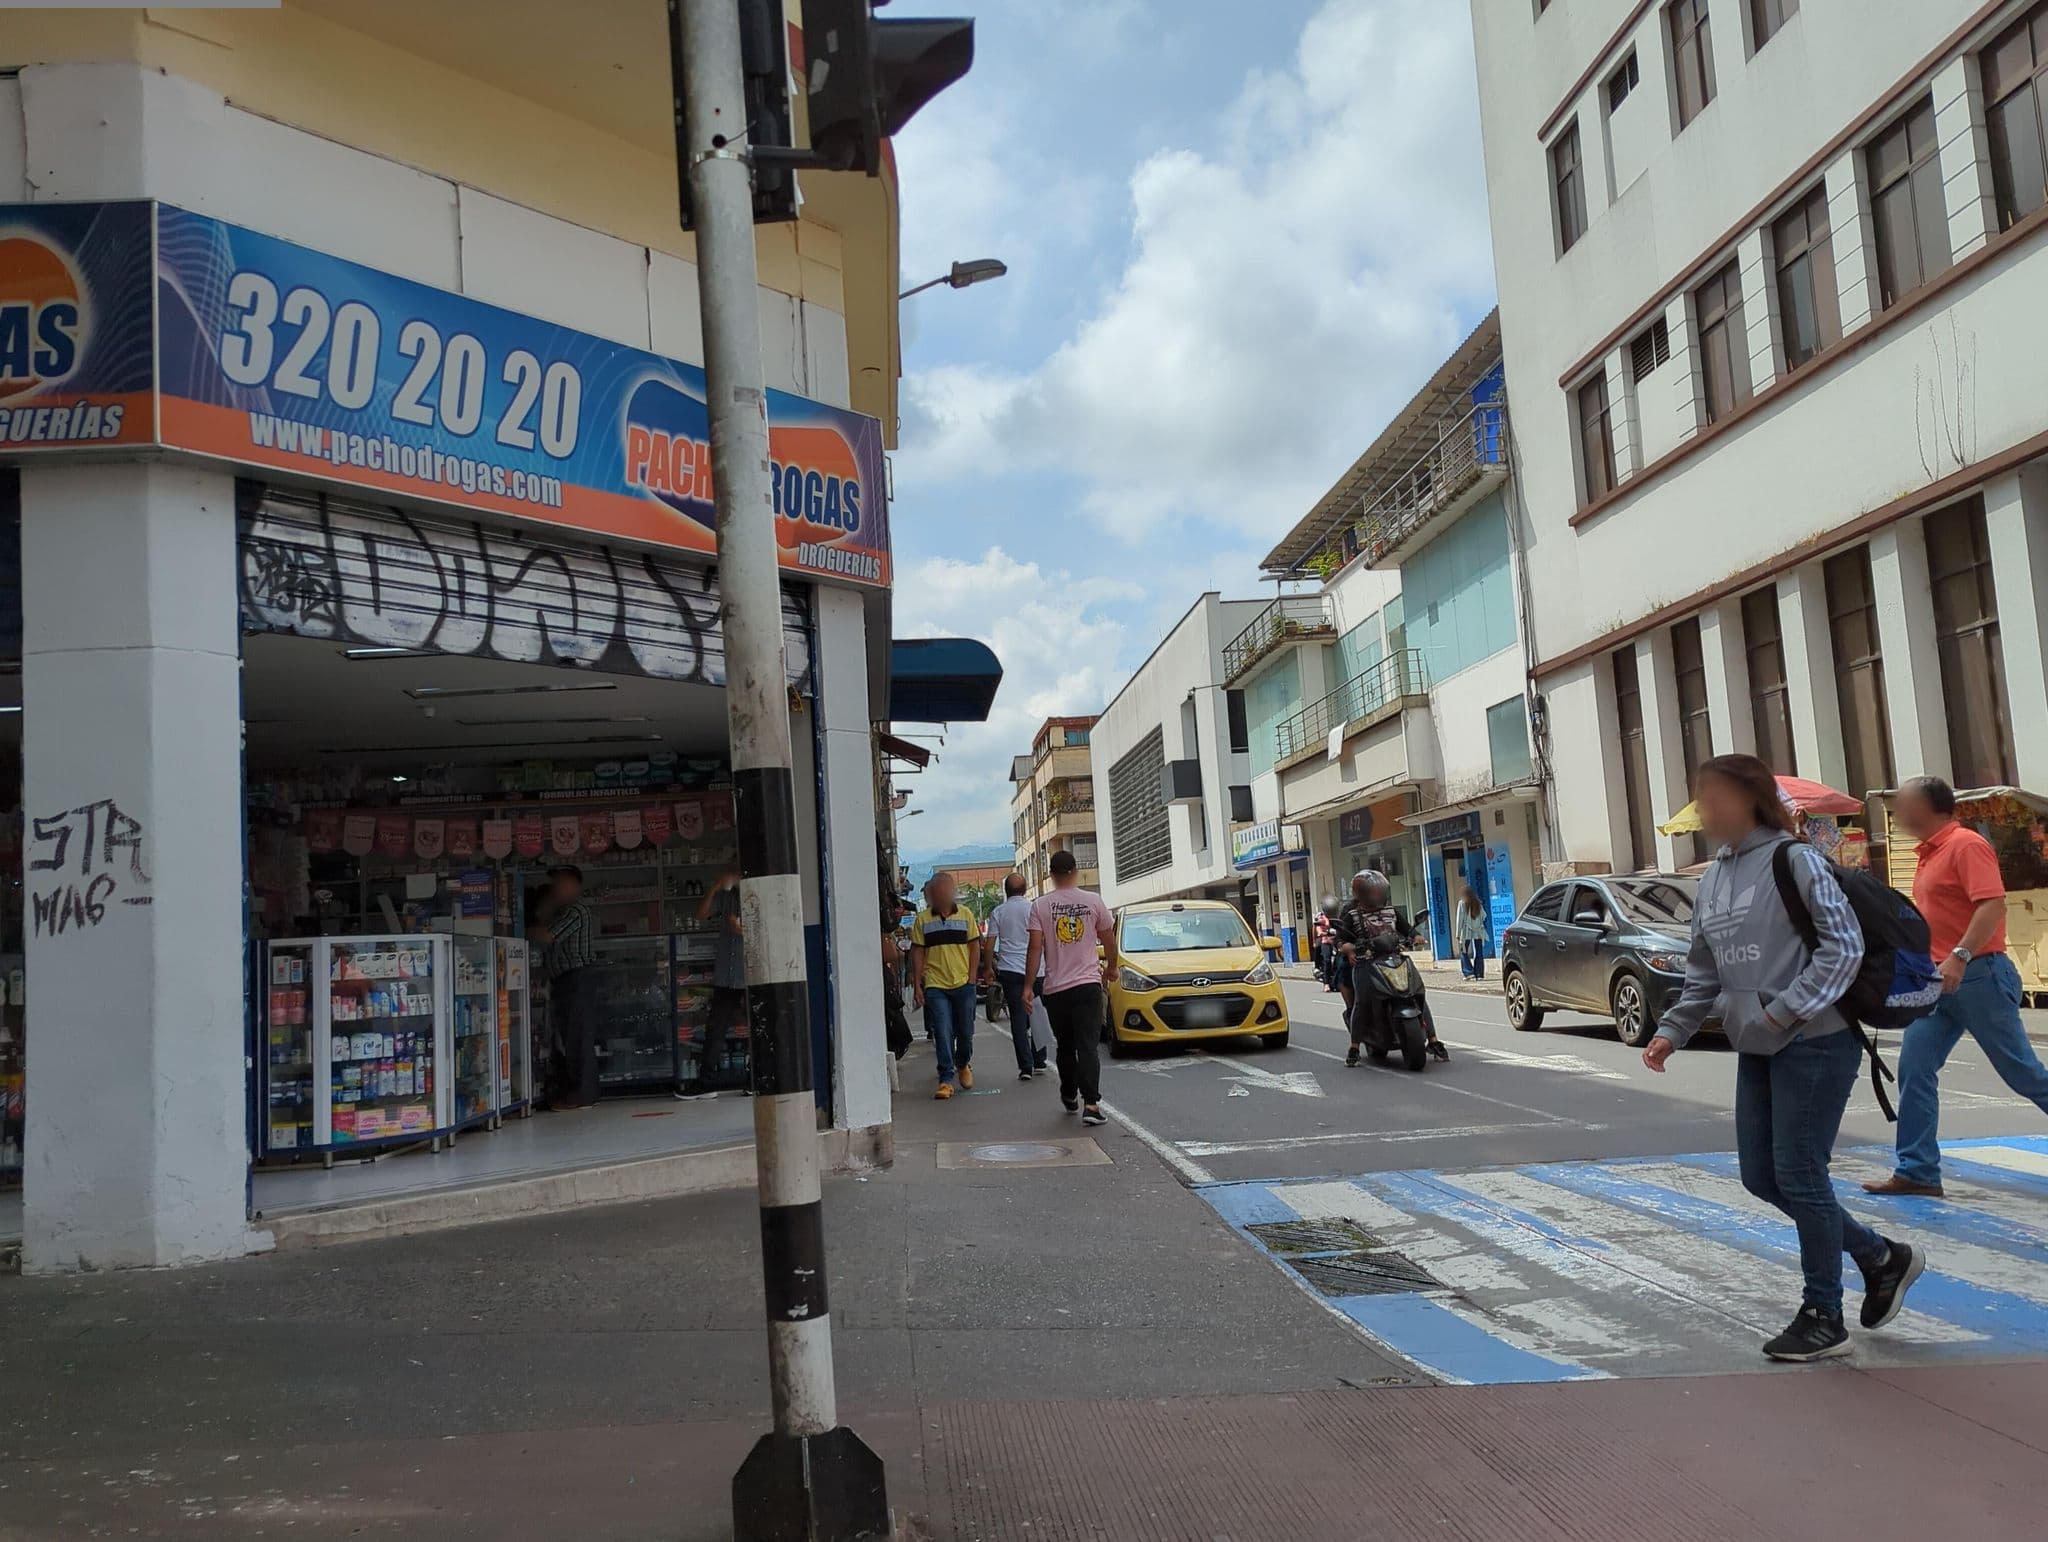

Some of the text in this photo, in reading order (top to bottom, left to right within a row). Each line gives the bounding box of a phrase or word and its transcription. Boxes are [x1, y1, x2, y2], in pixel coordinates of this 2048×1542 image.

[221, 271, 582, 458] 320 20 20
[798, 541, 881, 580] DROGUERÍAS
